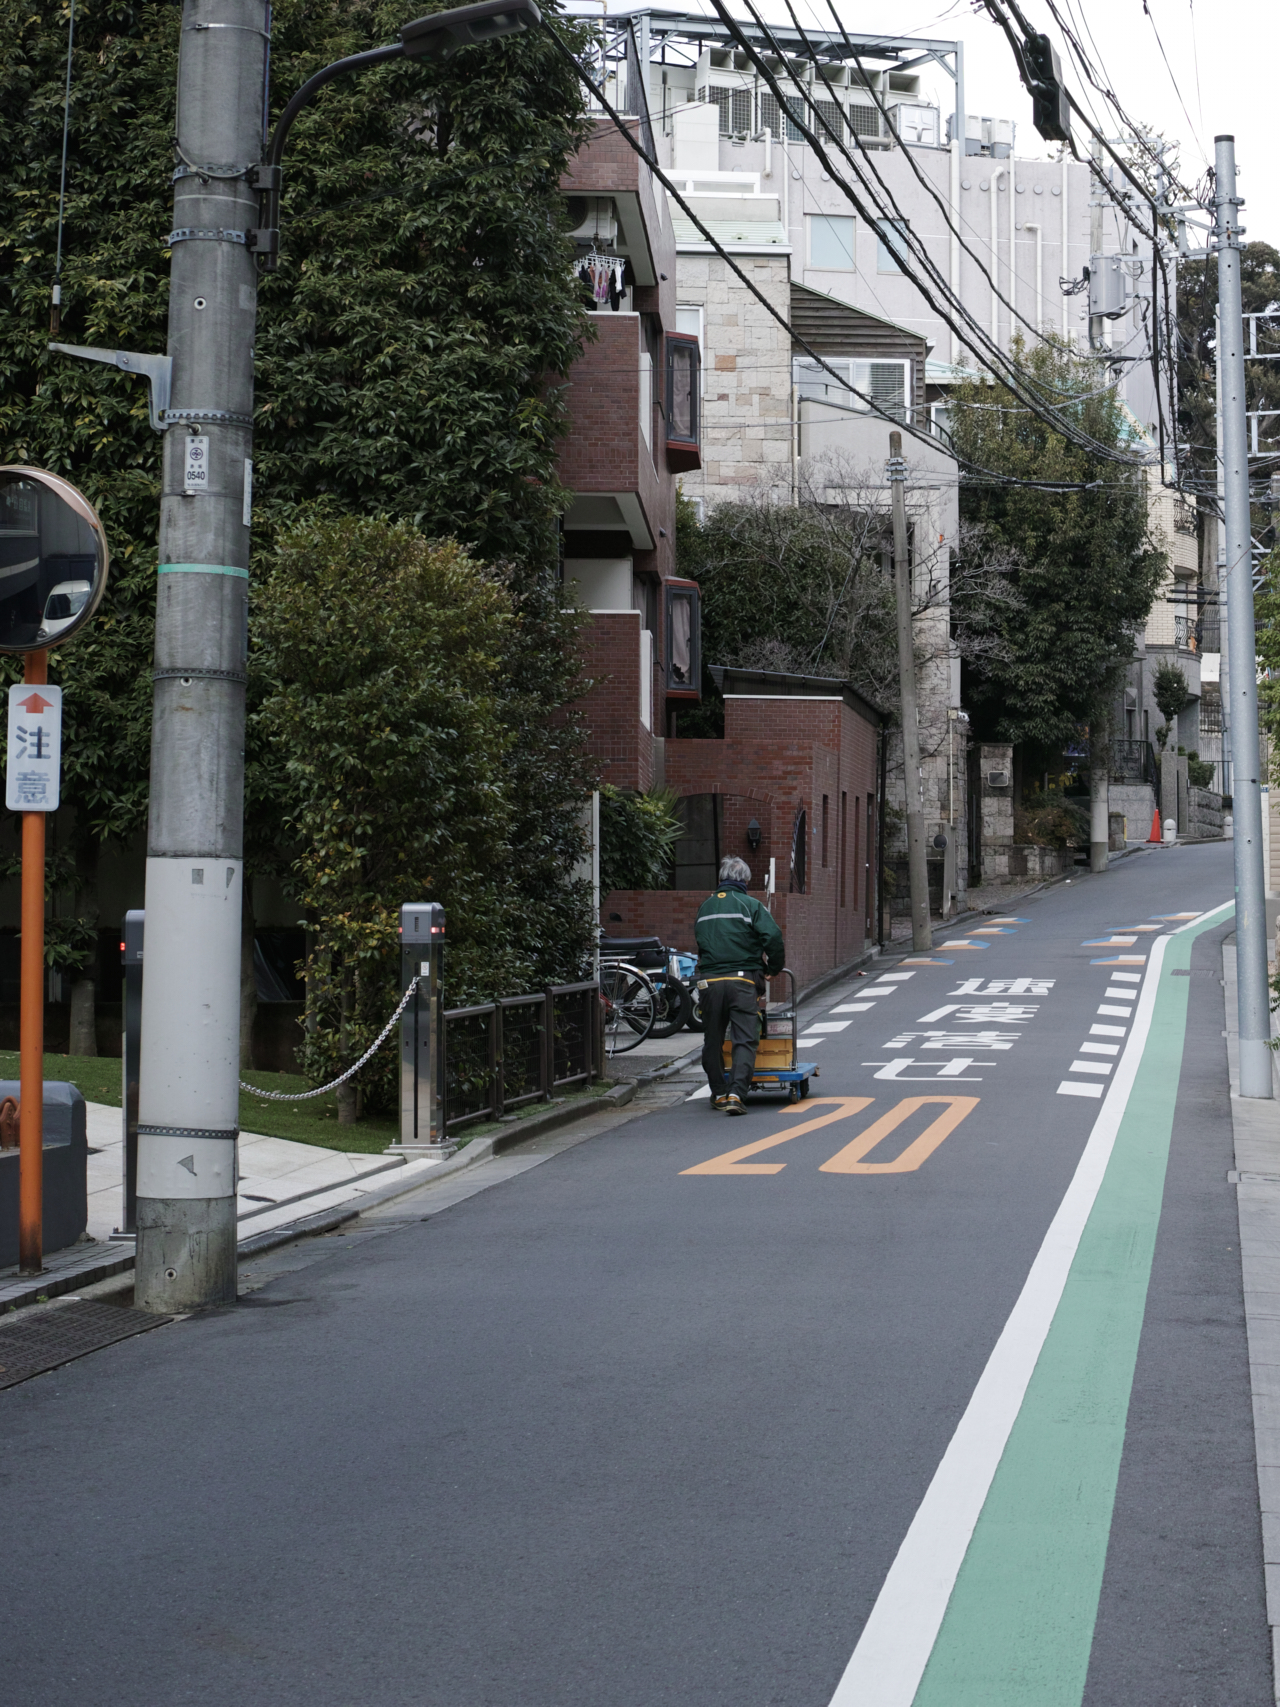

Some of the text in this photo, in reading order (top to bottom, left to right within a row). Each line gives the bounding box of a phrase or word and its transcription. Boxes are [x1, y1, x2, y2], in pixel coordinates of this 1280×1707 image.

[187, 470, 205, 480] 0540
[14, 725, 51, 804] 注意
[861, 978, 1056, 1081] 速度落せ
[678, 1096, 981, 1174] 20
